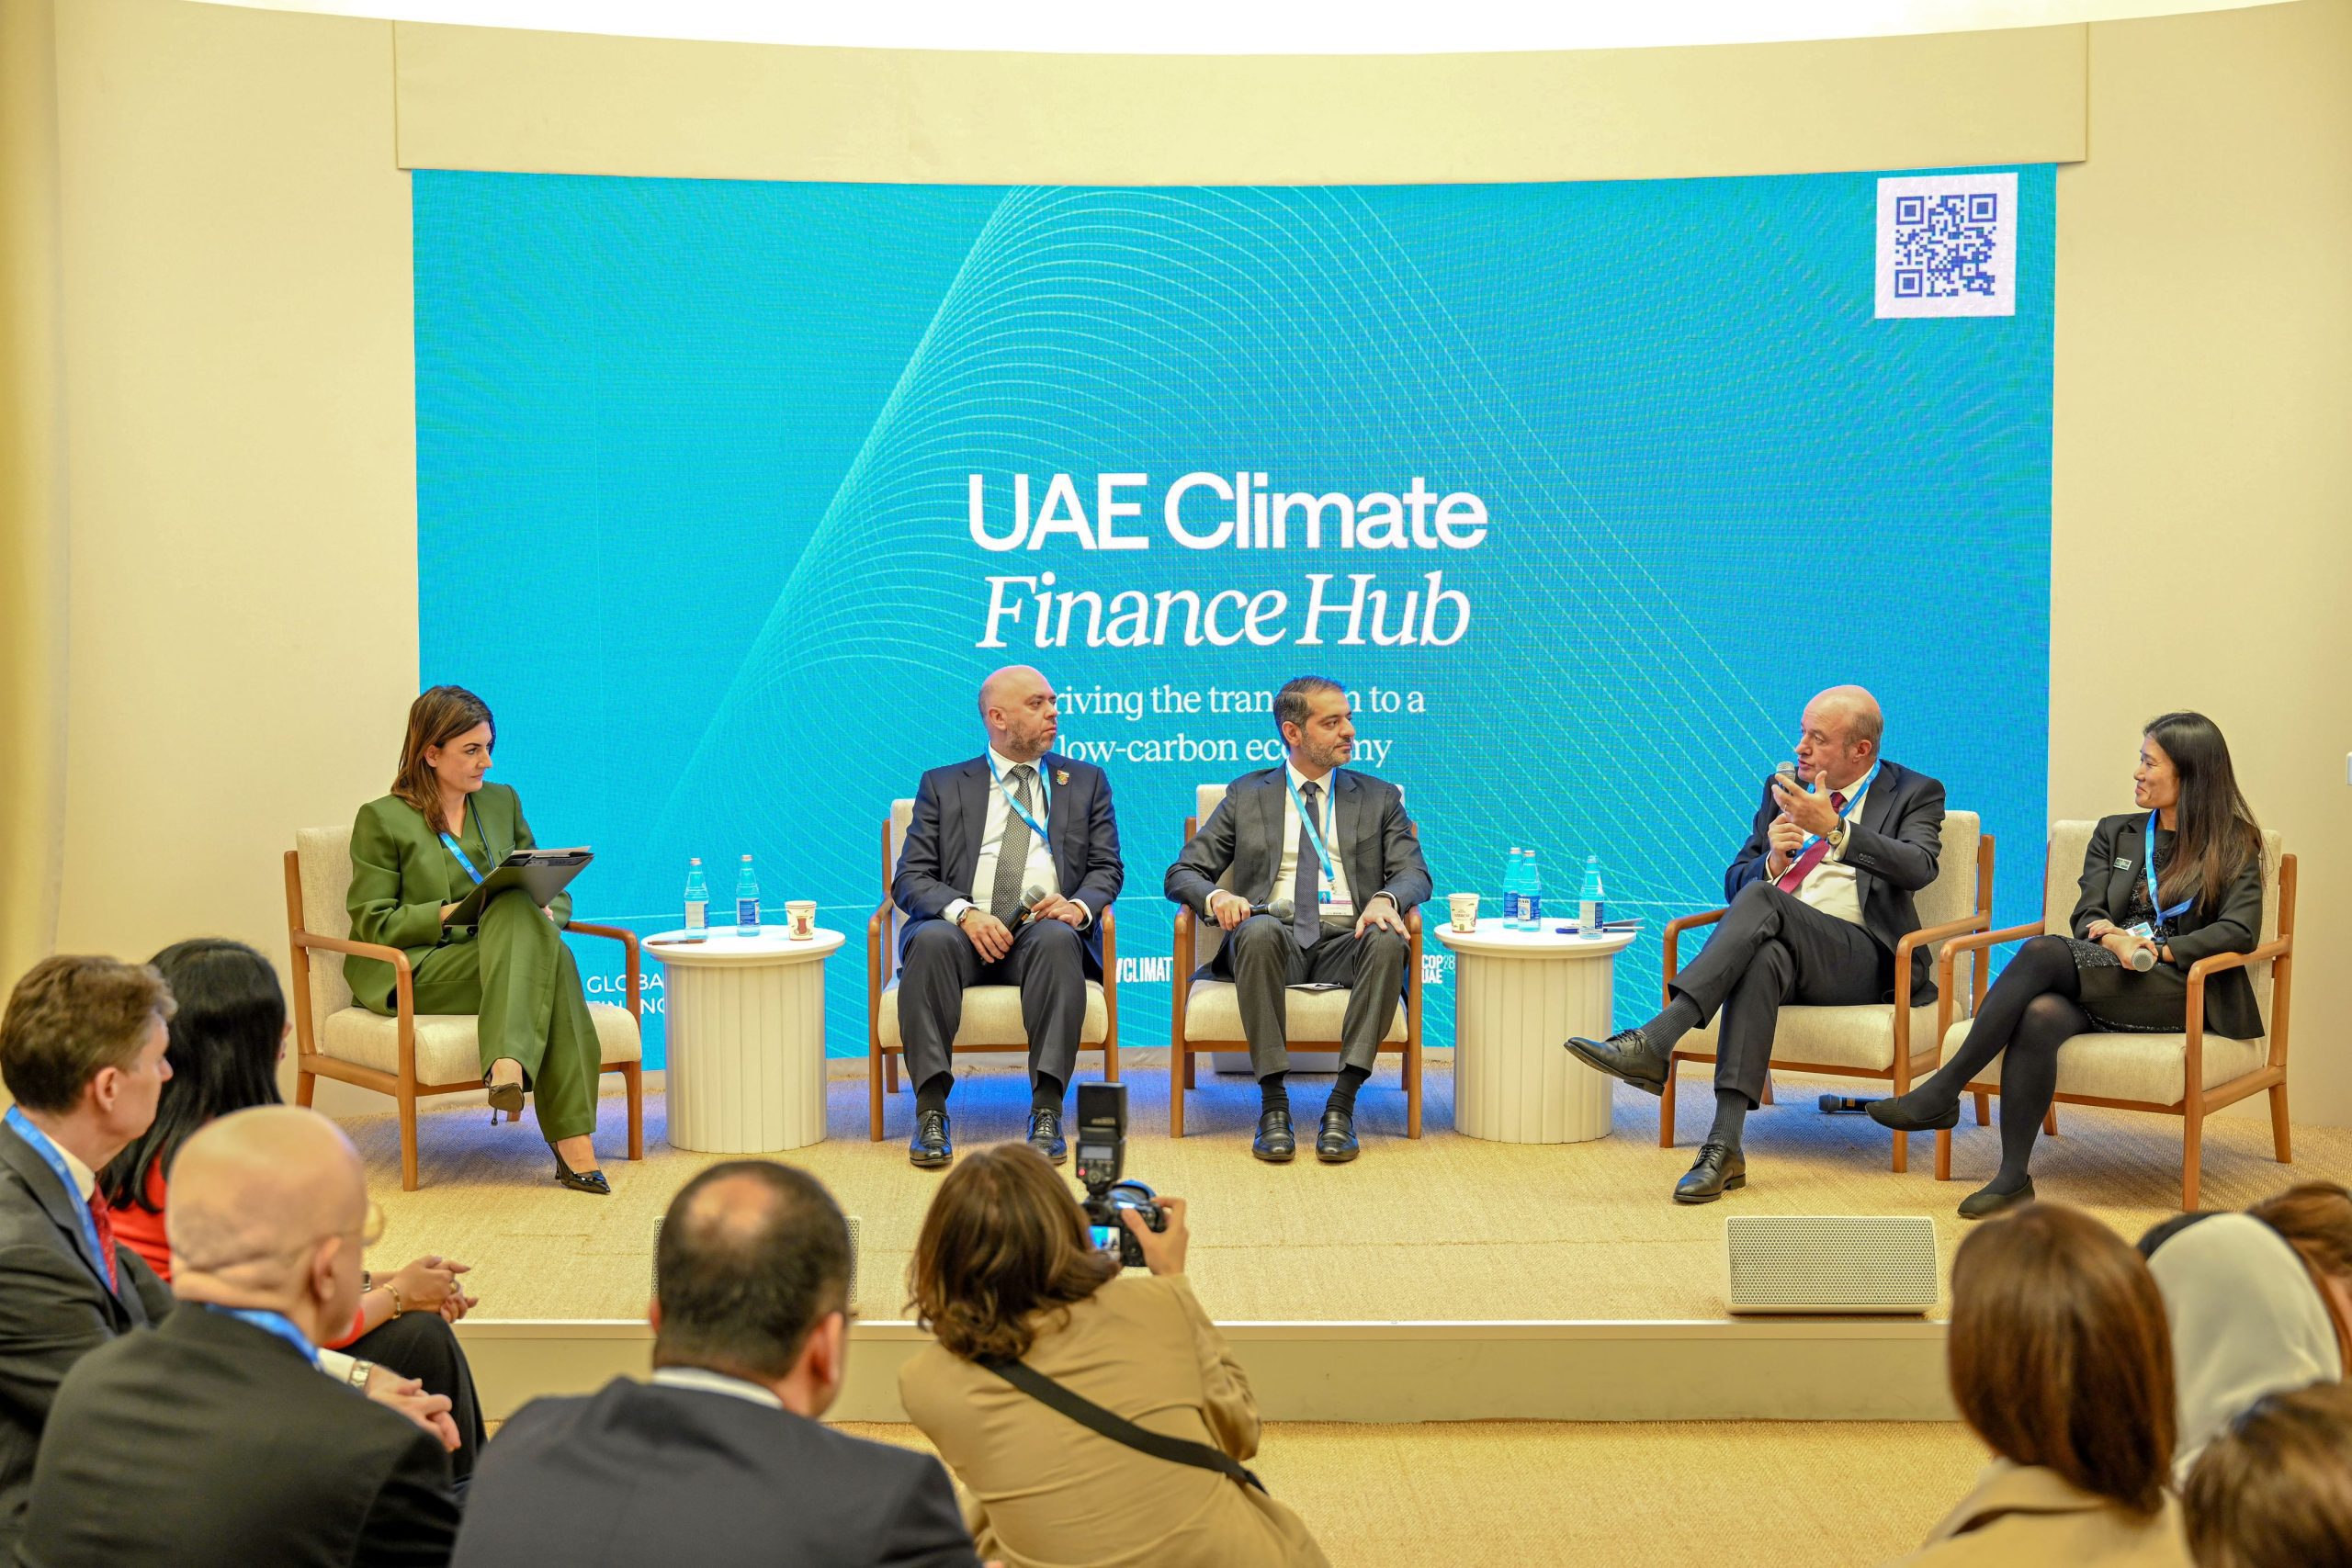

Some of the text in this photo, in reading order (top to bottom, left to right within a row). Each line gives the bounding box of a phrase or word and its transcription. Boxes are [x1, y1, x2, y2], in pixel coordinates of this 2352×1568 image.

[969, 471, 1487, 551] UAE Climate
[975, 570, 1471, 648] Finance Hub
[1054, 684, 1426, 721] riving the trann to a
[1057, 733, 1393, 768] low-carbon ecmy
[1421, 954, 1455, 970] COP28
[586, 973, 664, 993] GLOBA
